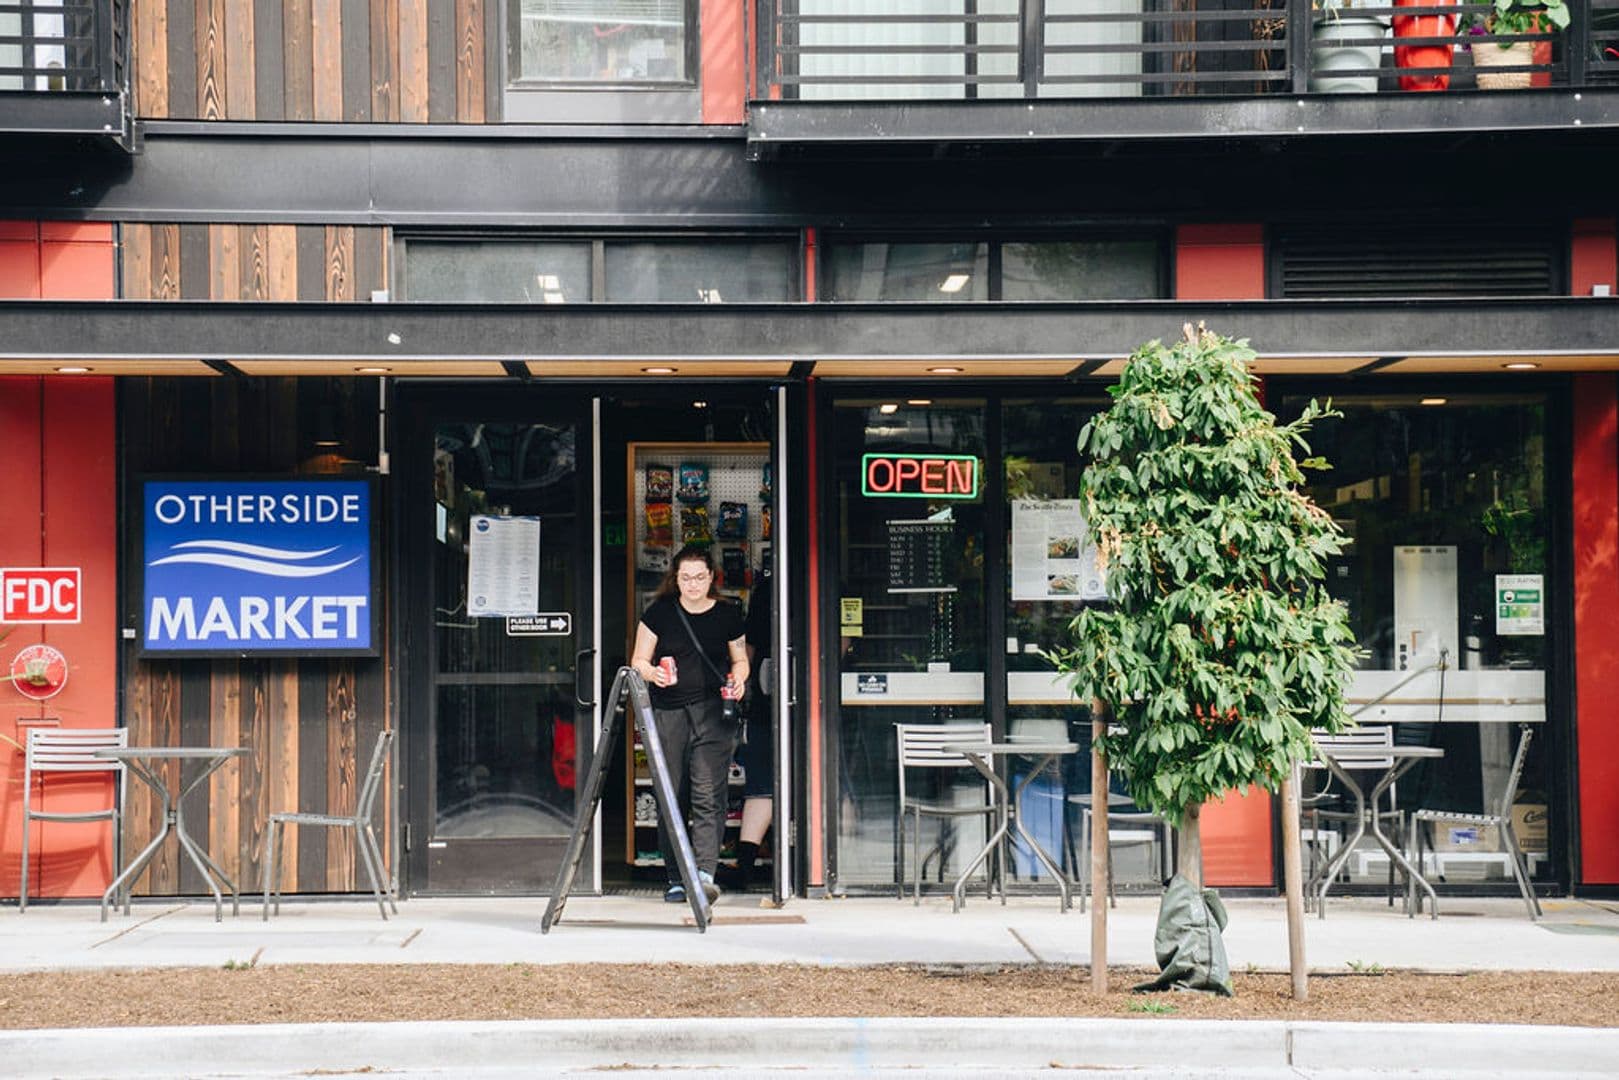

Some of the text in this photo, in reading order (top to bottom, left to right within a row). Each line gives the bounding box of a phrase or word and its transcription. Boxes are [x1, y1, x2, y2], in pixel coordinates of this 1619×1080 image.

[868, 458, 972, 493] OPEN
[154, 494, 360, 524] OTHERSIDE
[5, 576, 76, 614] FDC
[148, 595, 368, 641] MARKET
